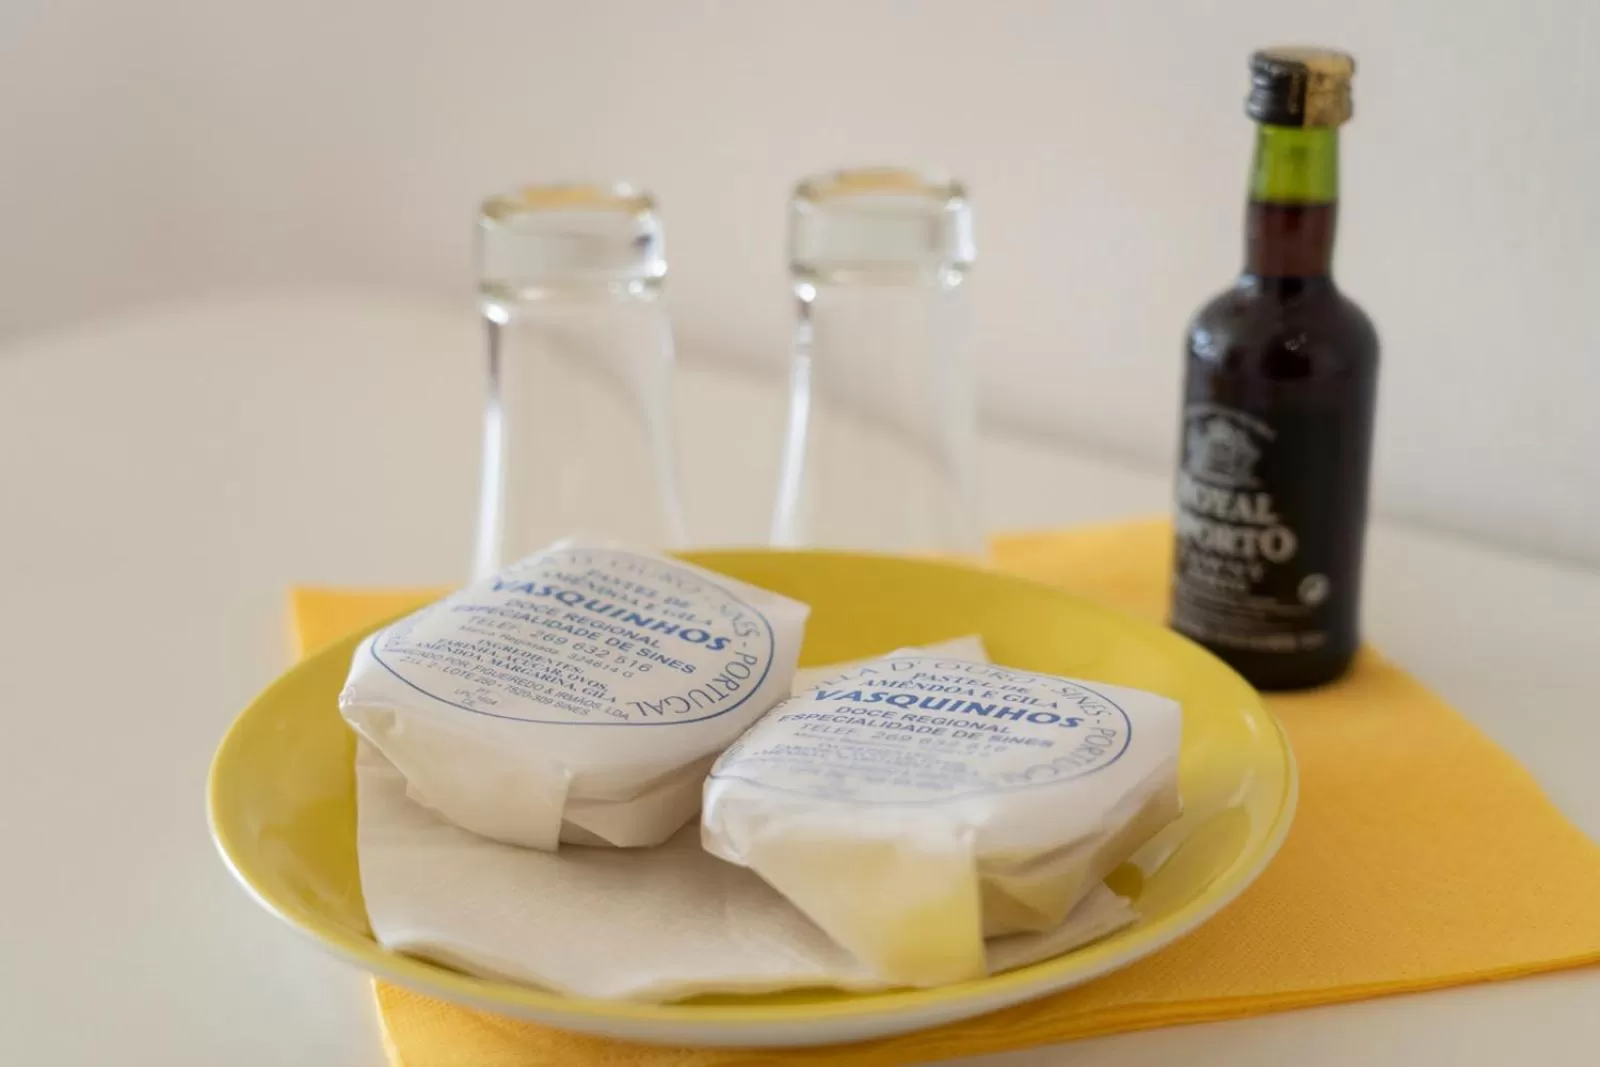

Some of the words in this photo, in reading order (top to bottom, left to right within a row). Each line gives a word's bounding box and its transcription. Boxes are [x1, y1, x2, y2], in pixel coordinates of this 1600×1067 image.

[490, 578, 732, 651] VASQUINHOS
[504, 598, 561, 617] DOCE
[562, 613, 661, 650] REGIONAL
[529, 630, 569, 646] 269
[571, 642, 611, 658] 632
[613, 655, 654, 673] 516
[604, 637, 634, 652] DE
[636, 648, 697, 674] SINES
[442, 666, 474, 681] LOTE
[626, 651, 758, 717] PORTUGAL
[911, 672, 993, 688] PASTEL
[999, 684, 1032, 694] DE
[815, 690, 1085, 728] VASQUINHOS
[1002, 693, 1058, 709] GILA
[777, 713, 950, 736] ESPECIALIDADE
[951, 730, 984, 740] DE
[834, 706, 898, 720] DOCE
[900, 713, 1012, 734] REGIONAL
